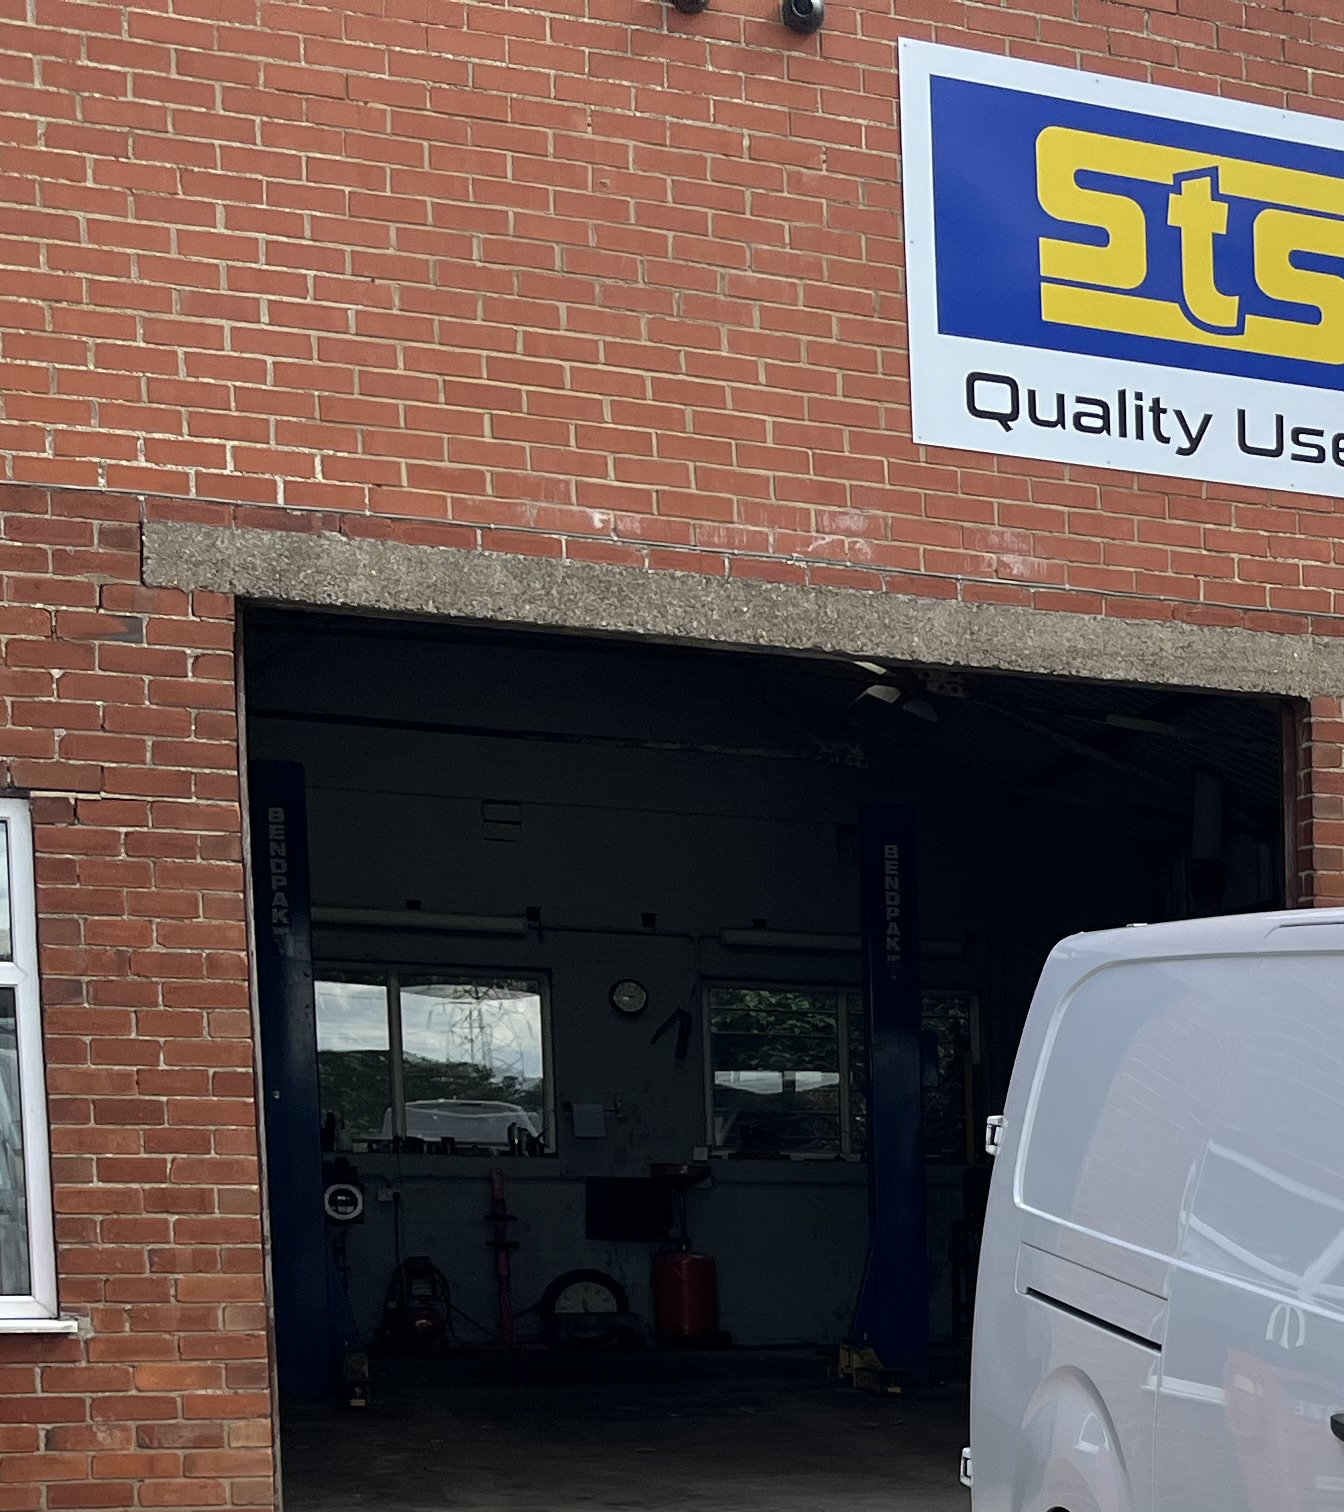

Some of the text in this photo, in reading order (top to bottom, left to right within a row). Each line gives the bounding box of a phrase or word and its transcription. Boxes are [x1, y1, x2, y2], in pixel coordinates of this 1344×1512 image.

[966, 371, 1213, 456] Quality
[268, 807, 289, 924] BENDPAK
[884, 845, 901, 951] BENDPAK
